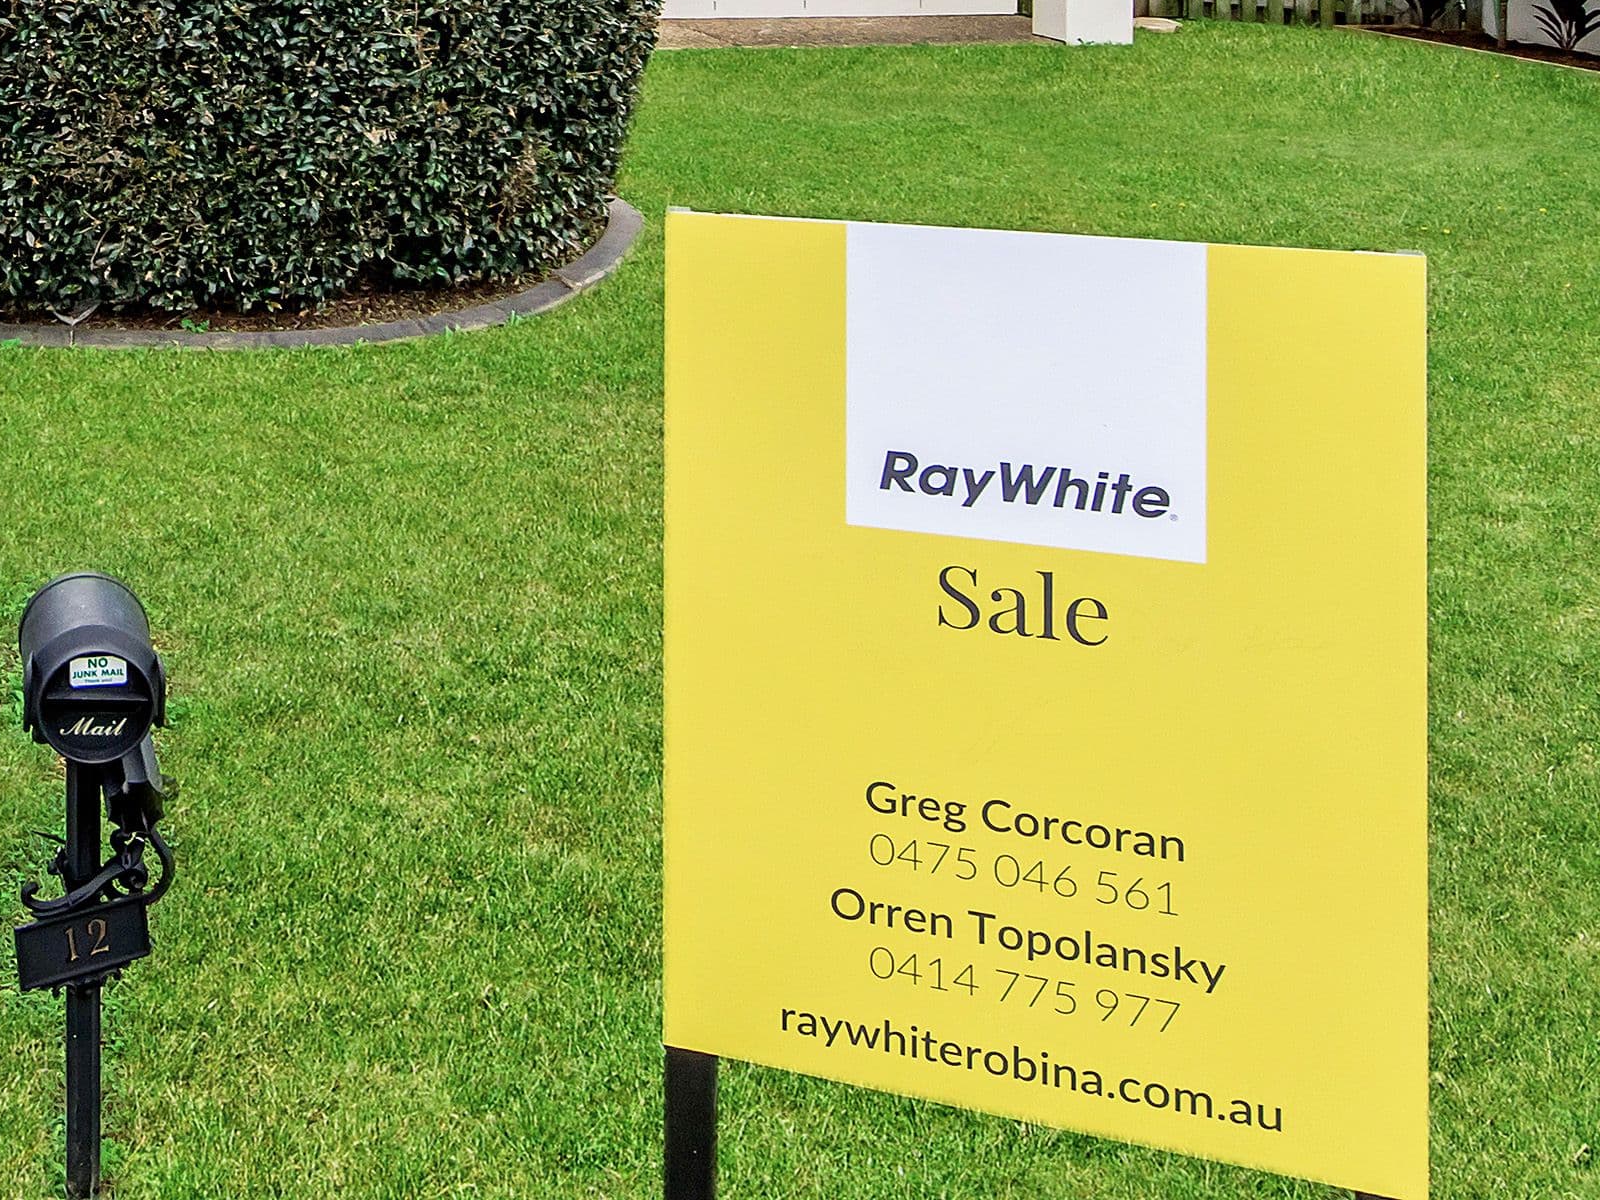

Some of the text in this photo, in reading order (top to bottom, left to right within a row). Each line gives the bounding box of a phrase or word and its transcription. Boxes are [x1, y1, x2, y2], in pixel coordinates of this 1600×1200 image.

[879, 450, 1171, 519] RayWhite
[937, 565, 1109, 647] Sale
[72, 668, 124, 679] JUNK MAIL
[87, 657, 108, 668] NO
[60, 716, 127, 736] Mail
[865, 781, 1185, 863] Greg Corcoran
[869, 833, 1179, 917] 0475 046 561
[65, 919, 110, 961] 12
[830, 887, 1227, 994] Orren Topolansky
[869, 946, 1181, 1033] 0414 775 977
[781, 1008, 1282, 1133] raywhiterobina.com.au
